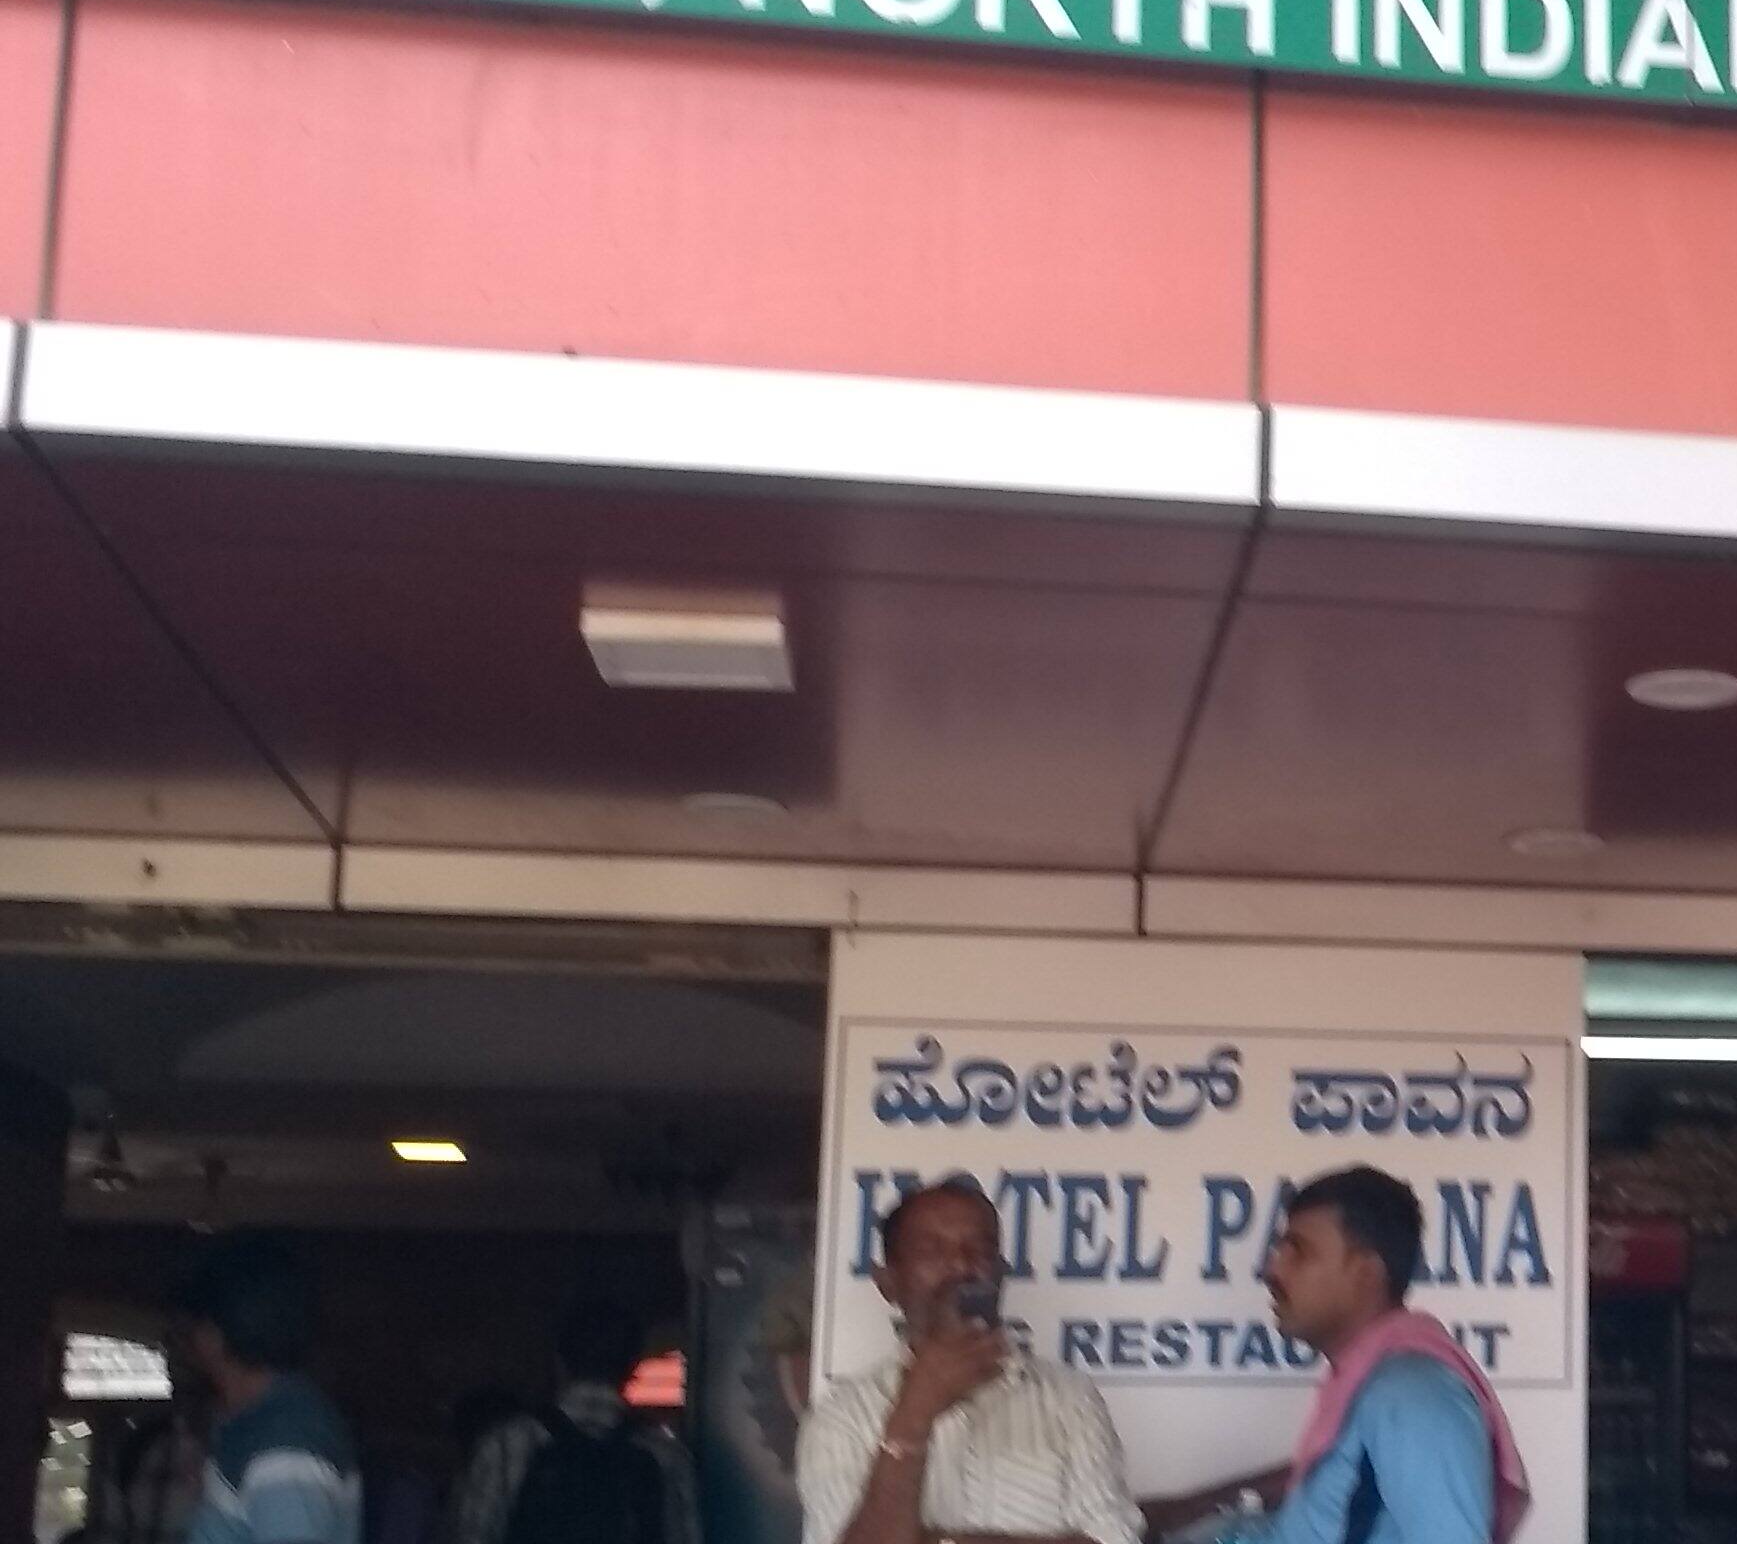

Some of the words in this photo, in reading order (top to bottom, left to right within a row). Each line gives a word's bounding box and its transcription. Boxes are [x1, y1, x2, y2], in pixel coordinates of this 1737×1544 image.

[870, 1033, 1244, 1133] ಹೋಟೆಲ್
[1289, 1049, 1535, 1140] ಪಾವನ
[850, 1169, 1170, 1280] HTEL
[1201, 1175, 1554, 1285] PNA
